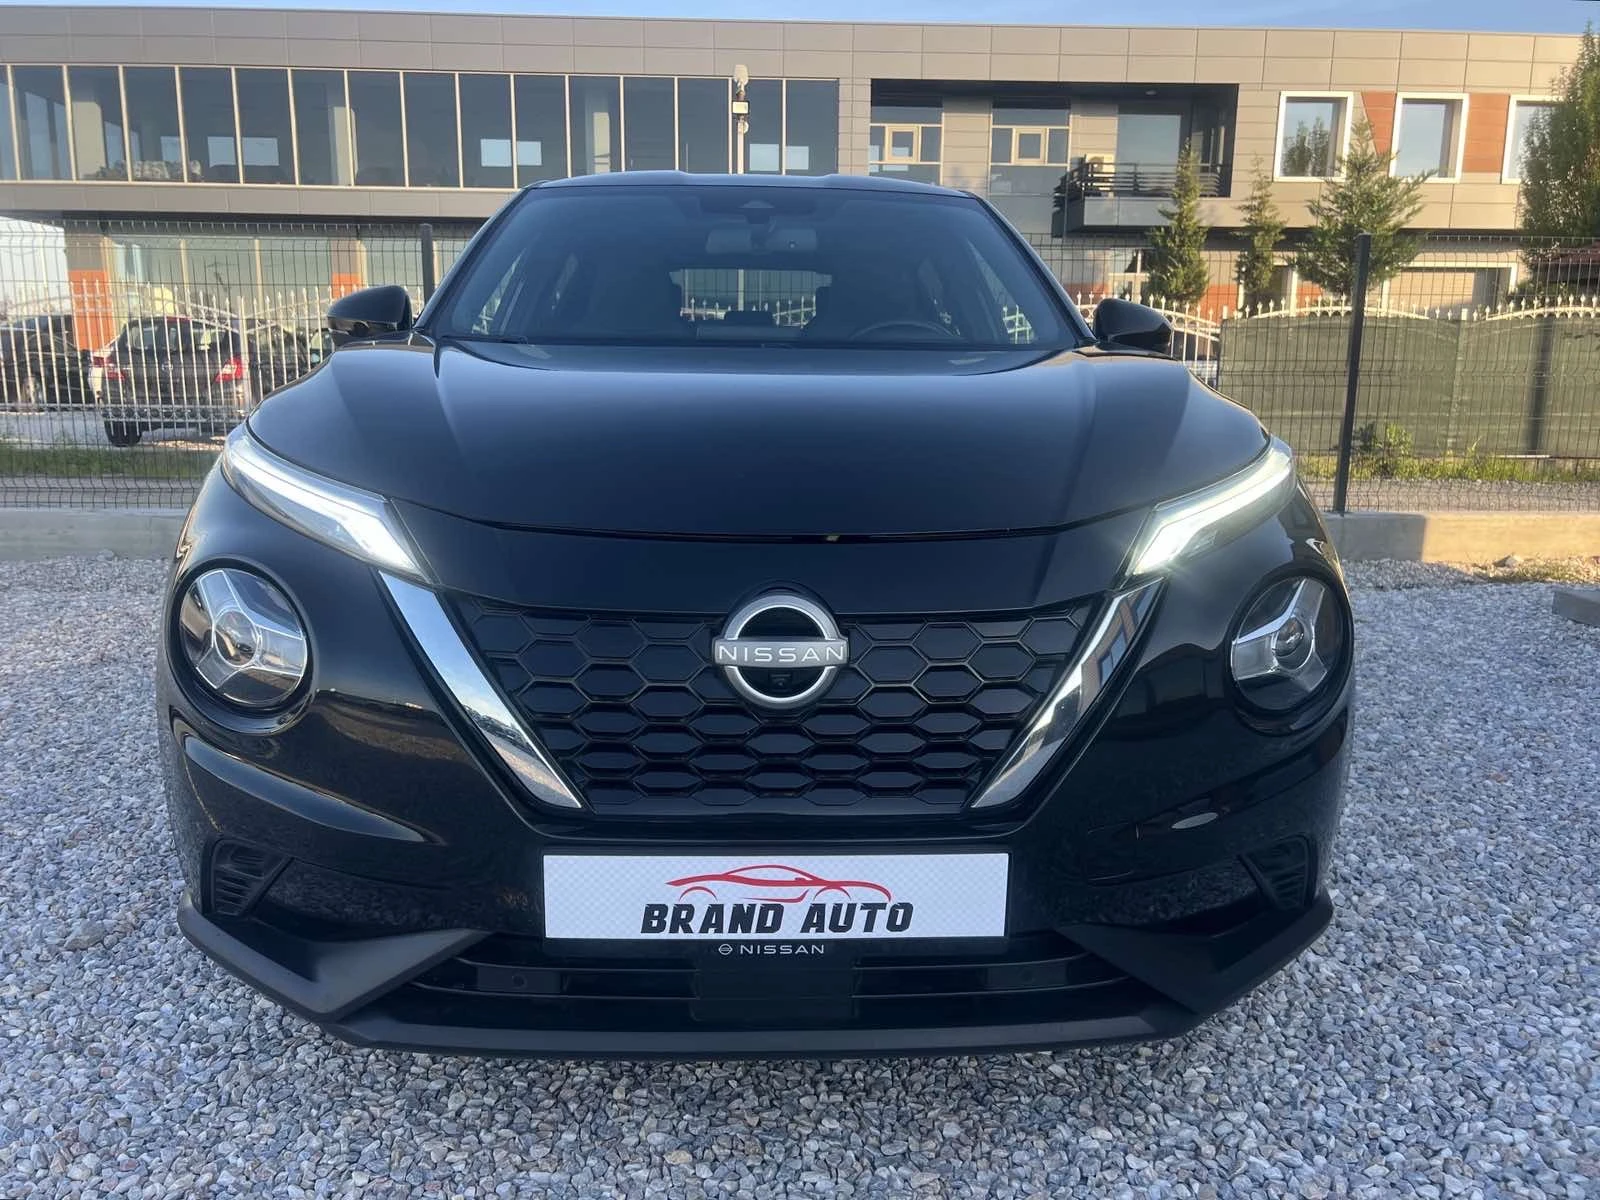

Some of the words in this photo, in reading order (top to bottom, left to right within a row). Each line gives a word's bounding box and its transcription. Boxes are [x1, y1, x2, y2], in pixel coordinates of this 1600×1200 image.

[718, 645, 844, 662] NISSAN
[640, 903, 784, 934] BRAND
[800, 902, 914, 933] AUTO
[739, 943, 825, 955] NISSAN
